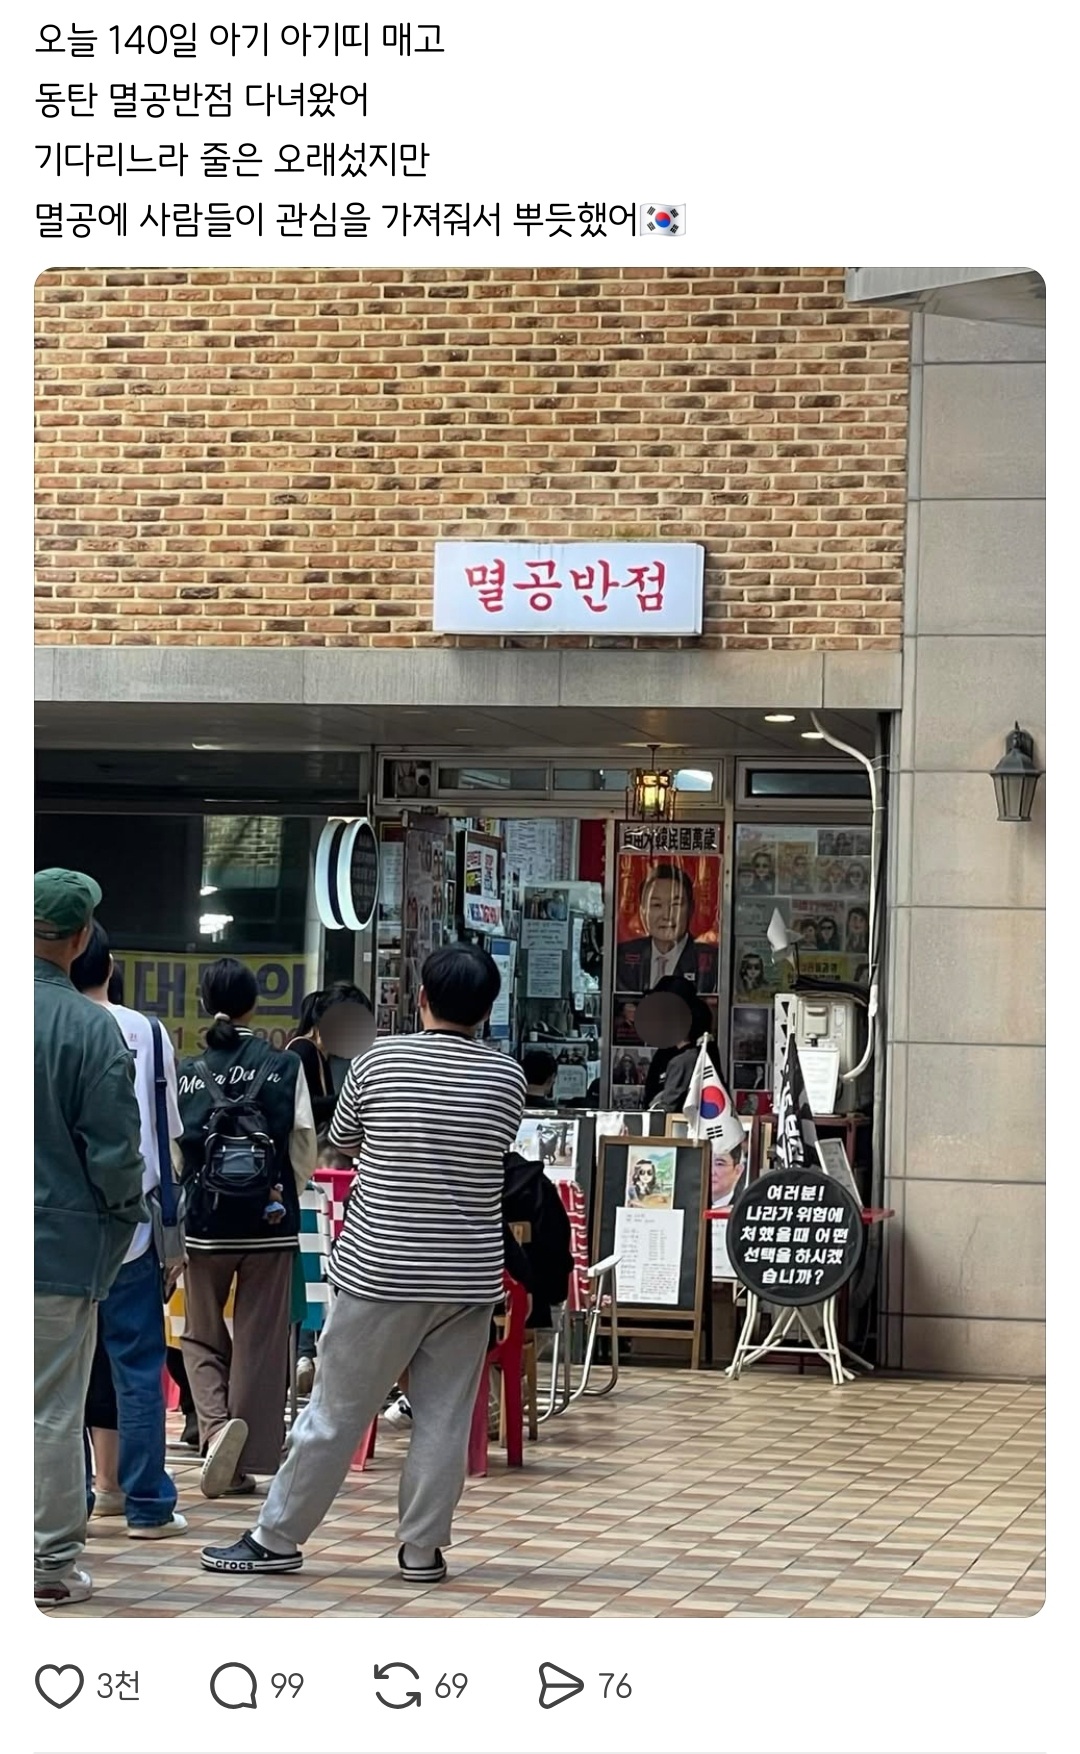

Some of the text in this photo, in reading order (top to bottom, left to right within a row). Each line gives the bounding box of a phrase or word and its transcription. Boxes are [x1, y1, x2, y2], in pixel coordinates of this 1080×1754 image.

[465, 558, 667, 613] 멸공반점
[178, 1072, 227, 1096] Meia
[767, 1185, 825, 1202] 여러분!
[746, 1206, 844, 1223] 나라가 위험에
[815, 1227, 849, 1244] 어떤
[744, 1247, 844, 1265] 선택을 하시겠
[762, 1268, 824, 1285] 습니까?
[215, 1560, 254, 1570] crocs
